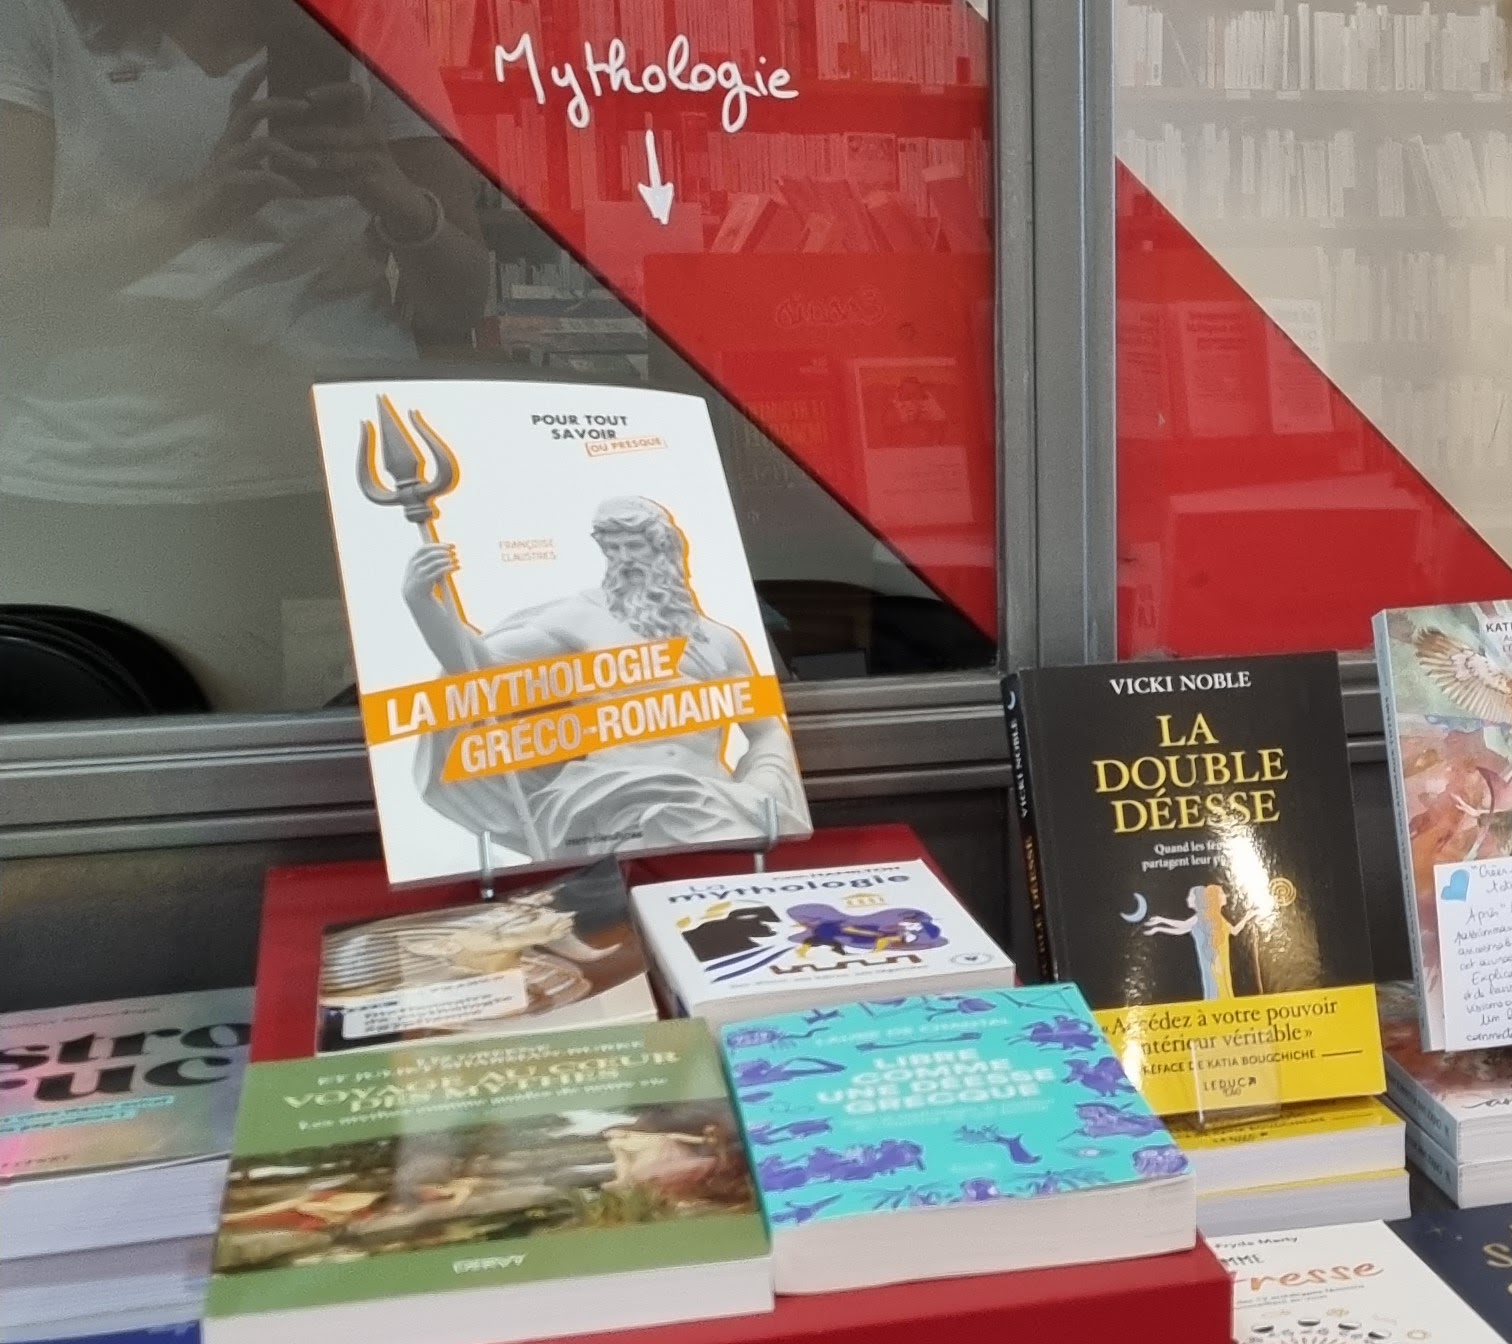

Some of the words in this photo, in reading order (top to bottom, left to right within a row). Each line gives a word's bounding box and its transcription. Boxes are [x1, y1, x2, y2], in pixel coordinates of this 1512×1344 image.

[494, 33, 799, 133] Mythologie
[531, 414, 579, 426] POUR
[584, 415, 628, 426] TOUT
[552, 428, 616, 440] SAVOIR
[386, 695, 436, 736] LA
[445, 641, 674, 723] MYTHOLOGIE
[1110, 675, 1174, 696] VICKI
[1179, 670, 1252, 692] NOBLE
[461, 681, 756, 773] GRÉCO-ROMAINE
[1156, 712, 1219, 747] LA
[1092, 748, 1289, 794] DOUBLE
[1111, 786, 1281, 834] DÉESSE
[1154, 841, 1187, 855] Quand
[1189, 842, 1204, 853] les
[1142, 856, 1189, 872] partagent
[1192, 855, 1210, 867] leur
[668, 873, 911, 904] mythologie
[1197, 1009, 1207, 1027] à
[1213, 1009, 1261, 1026] votre
[1266, 998, 1337, 1021] pouvoir
[851, 1058, 1011, 1087] COMME
[874, 1047, 979, 1070] LIBRE
[1207, 1058, 1239, 1070] KATIA
[817, 1084, 899, 1105] UNE
[911, 1068, 1057, 1094] DÉESSE
[844, 1082, 1042, 1114] GRECQUE
